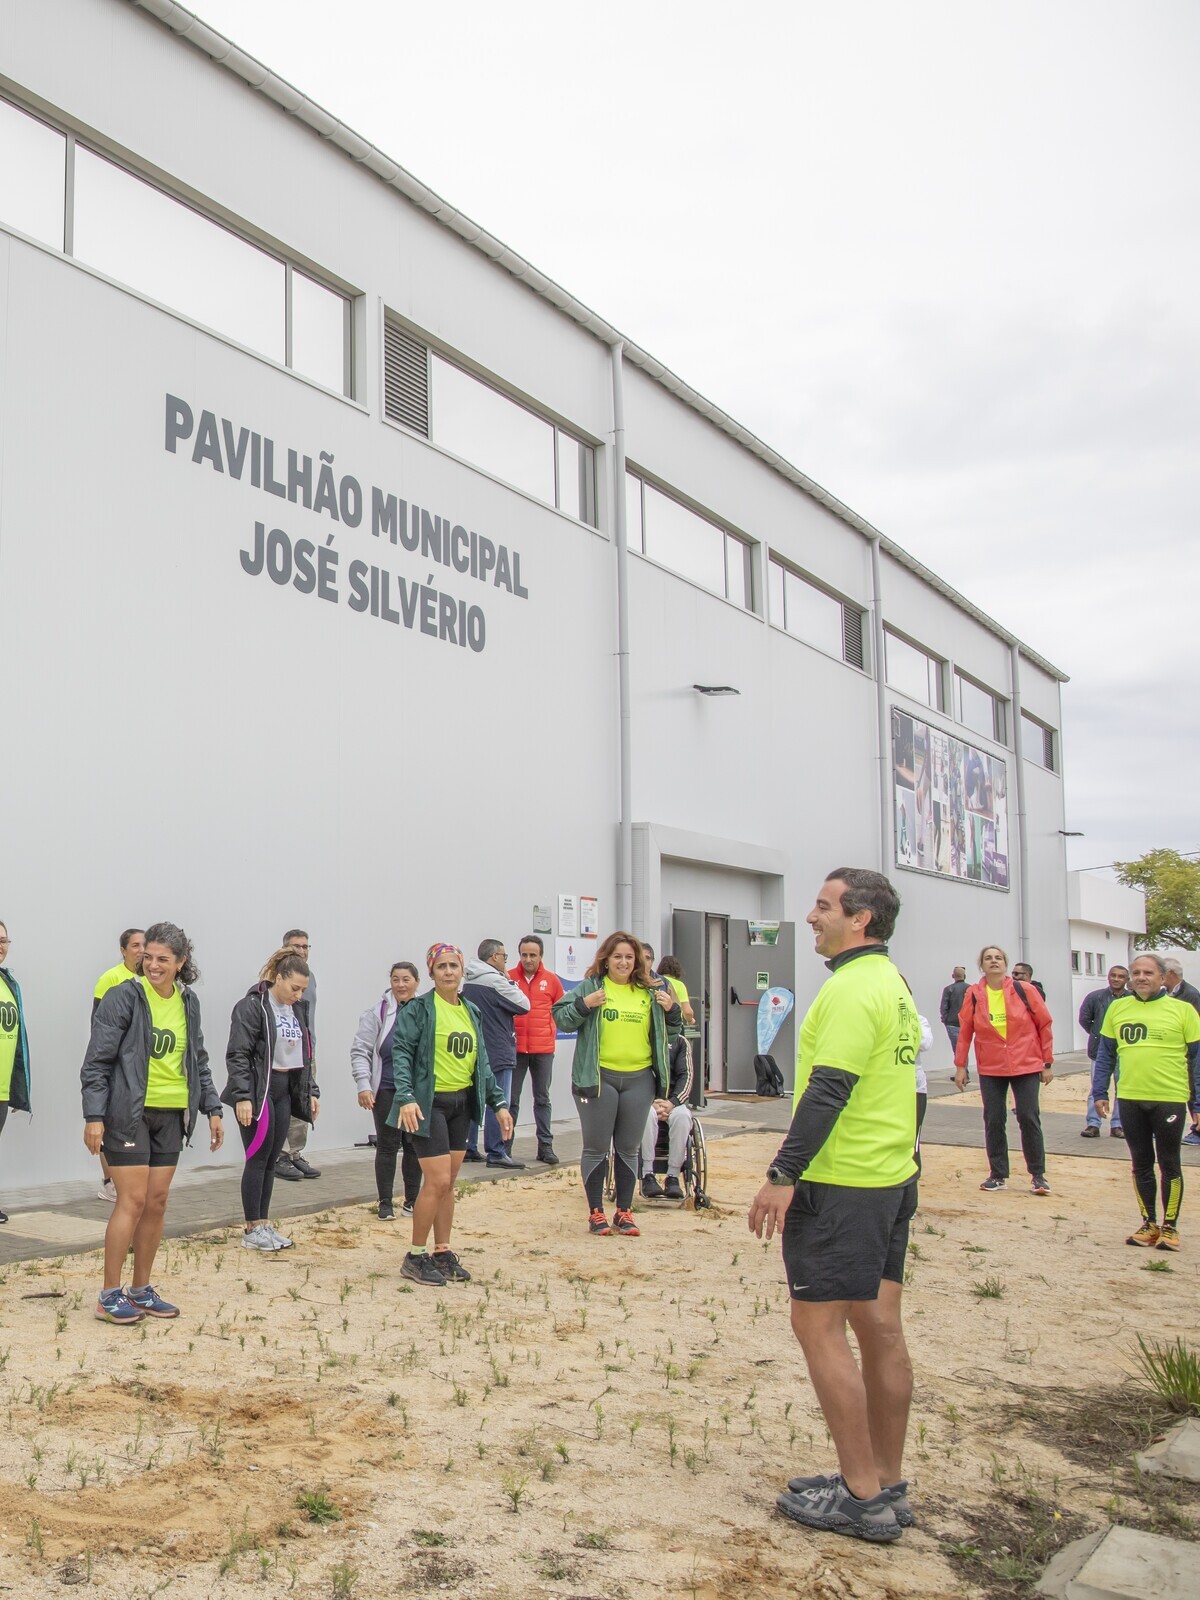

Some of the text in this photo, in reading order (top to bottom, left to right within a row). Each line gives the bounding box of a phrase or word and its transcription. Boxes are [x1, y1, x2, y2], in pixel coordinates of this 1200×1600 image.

[164, 393, 529, 599] PAVILHÃO MUNICIPAL
[239, 521, 486, 653] JOSÉ SILVÉRIO
[281, 1029, 301, 1038] 1989
